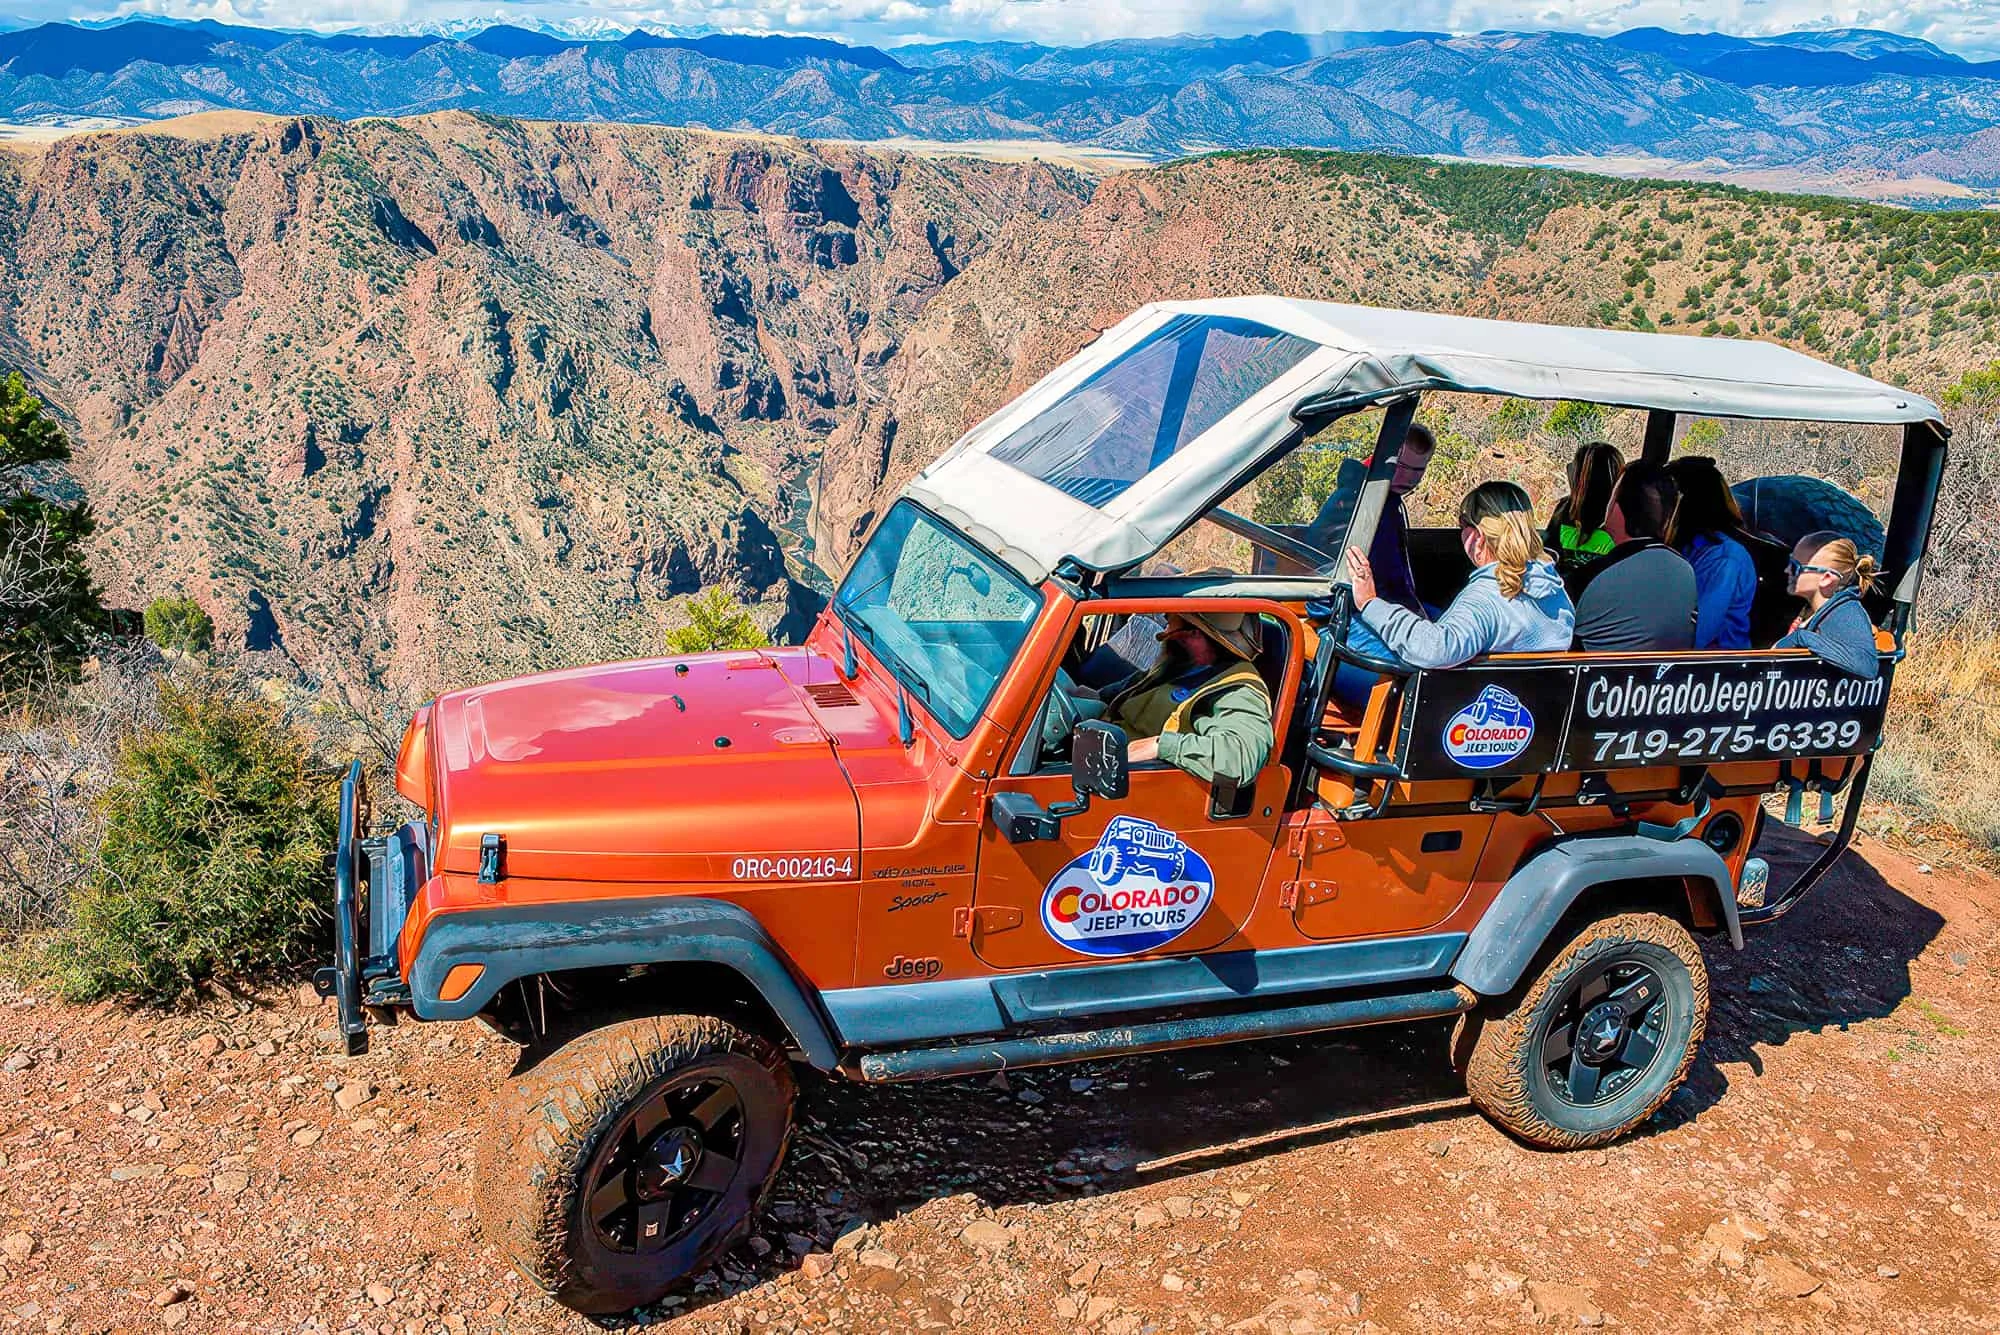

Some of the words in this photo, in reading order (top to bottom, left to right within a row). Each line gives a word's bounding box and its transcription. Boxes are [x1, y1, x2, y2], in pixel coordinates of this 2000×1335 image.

[1587, 672, 1883, 719] ColoradoJeepTours.com
[1450, 724, 1527, 746] COLORADO
[1593, 720, 1861, 762] 719-275-6339
[732, 856, 852, 878] ORC-00216-4
[1051, 885, 1199, 923] COLORADO
[1083, 914, 1126, 933] JEEP
[1131, 908, 1186, 928] TOURS
[884, 955, 943, 979] Jeep
